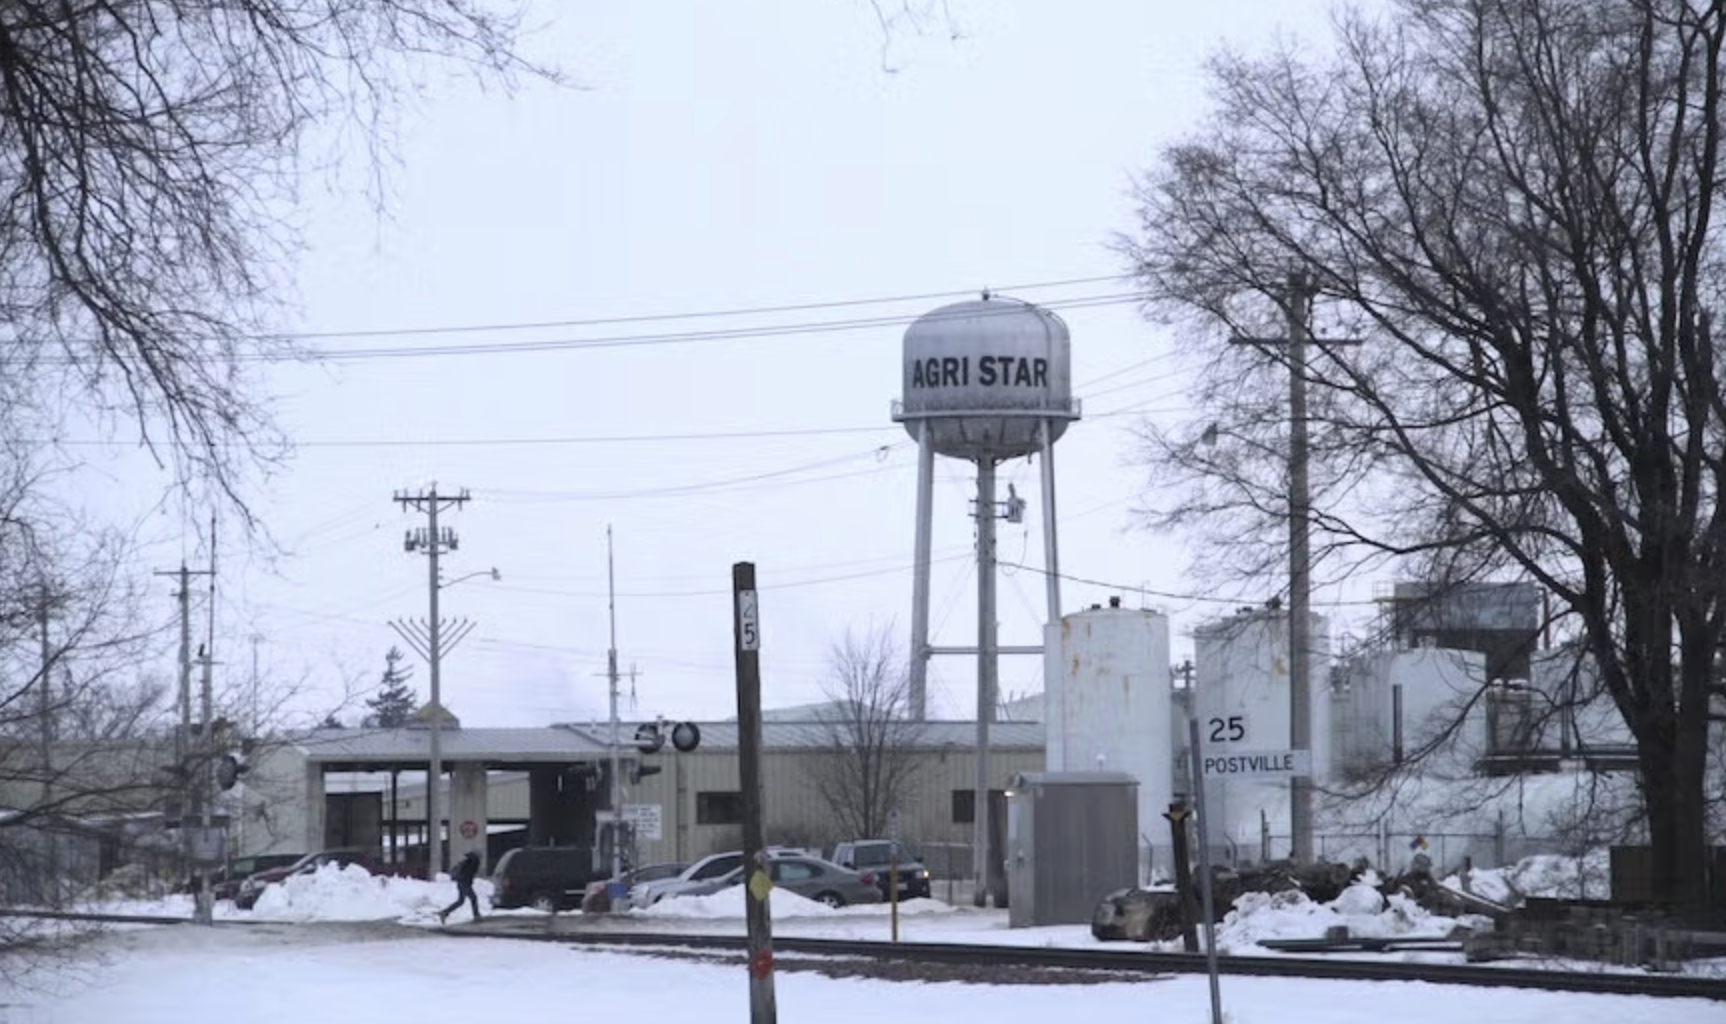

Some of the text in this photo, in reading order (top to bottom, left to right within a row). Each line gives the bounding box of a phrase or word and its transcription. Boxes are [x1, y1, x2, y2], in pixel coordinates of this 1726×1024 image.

[913, 355, 1048, 388] AGRI STAR
[1209, 716, 1245, 742] 25
[1204, 754, 1294, 774] POSTVILLE
